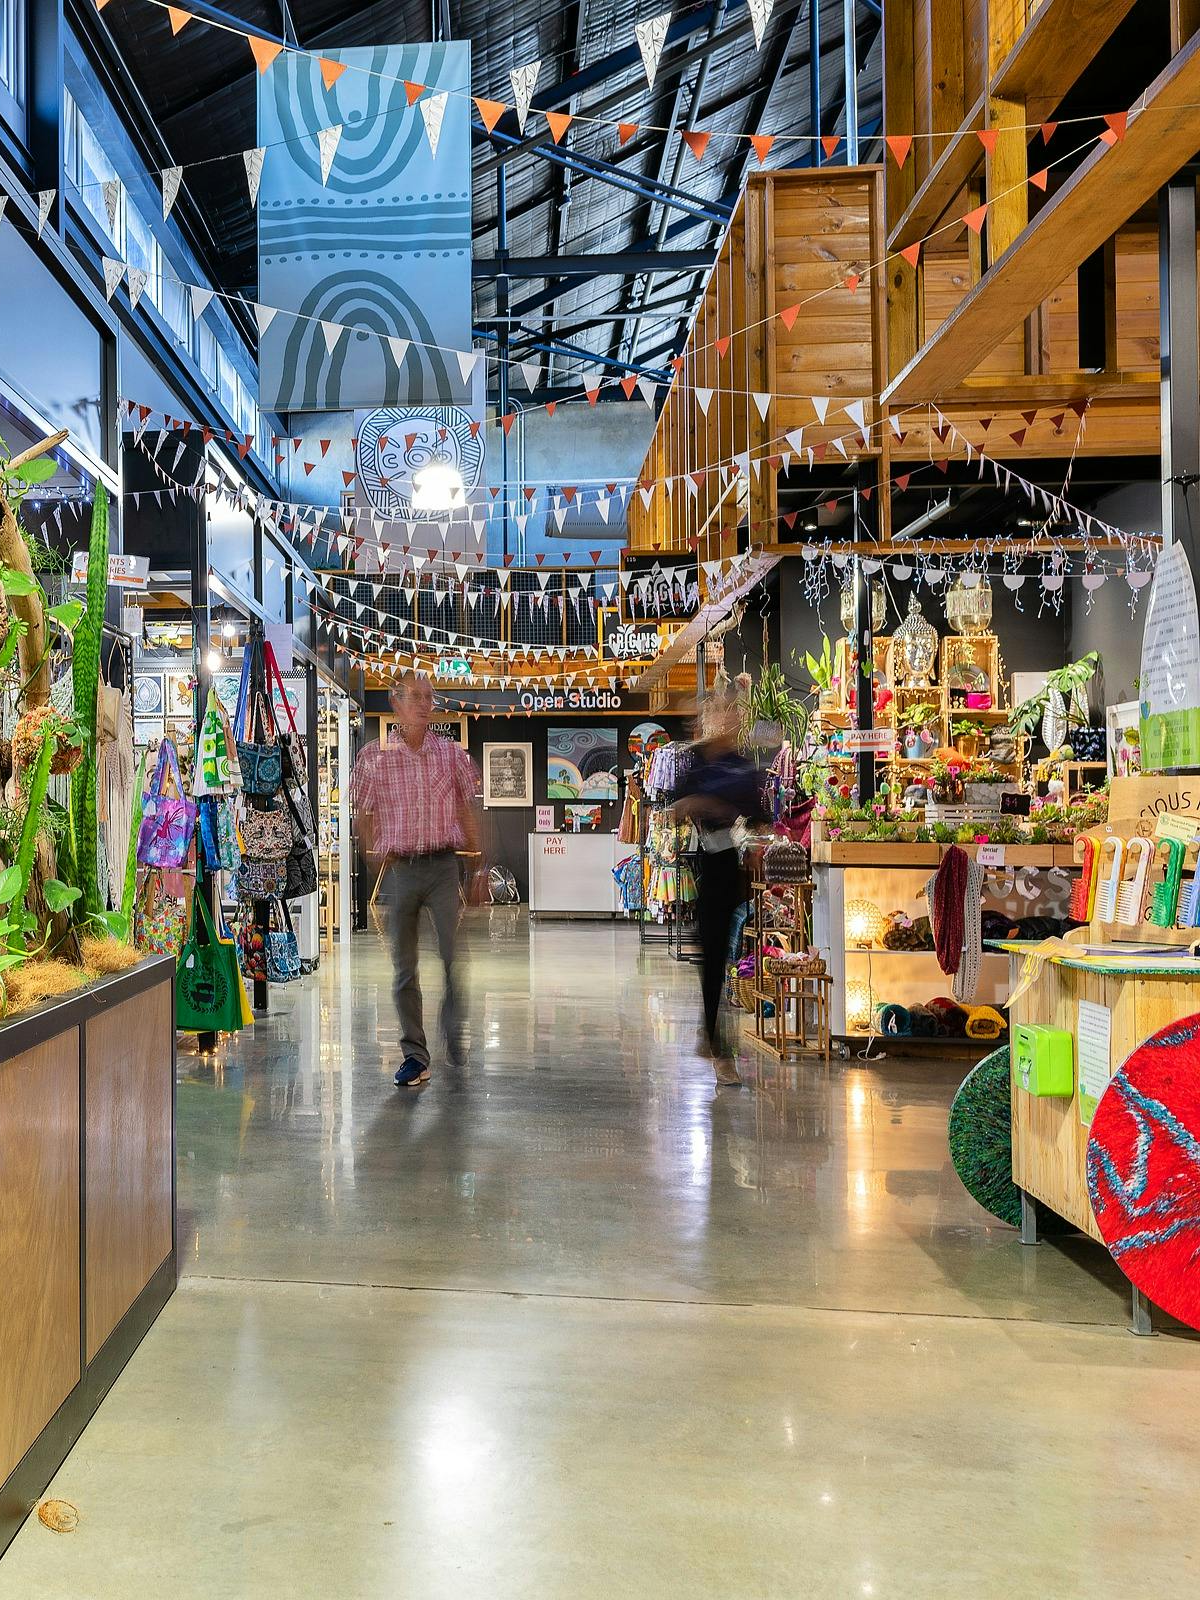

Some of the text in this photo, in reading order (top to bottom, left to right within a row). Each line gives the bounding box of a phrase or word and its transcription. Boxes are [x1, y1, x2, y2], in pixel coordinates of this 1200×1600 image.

[520, 692, 622, 711] Open Studio
[850, 732, 888, 740] PAY HERE
[546, 837, 563, 845] PAY
[543, 847, 566, 855] HERE
